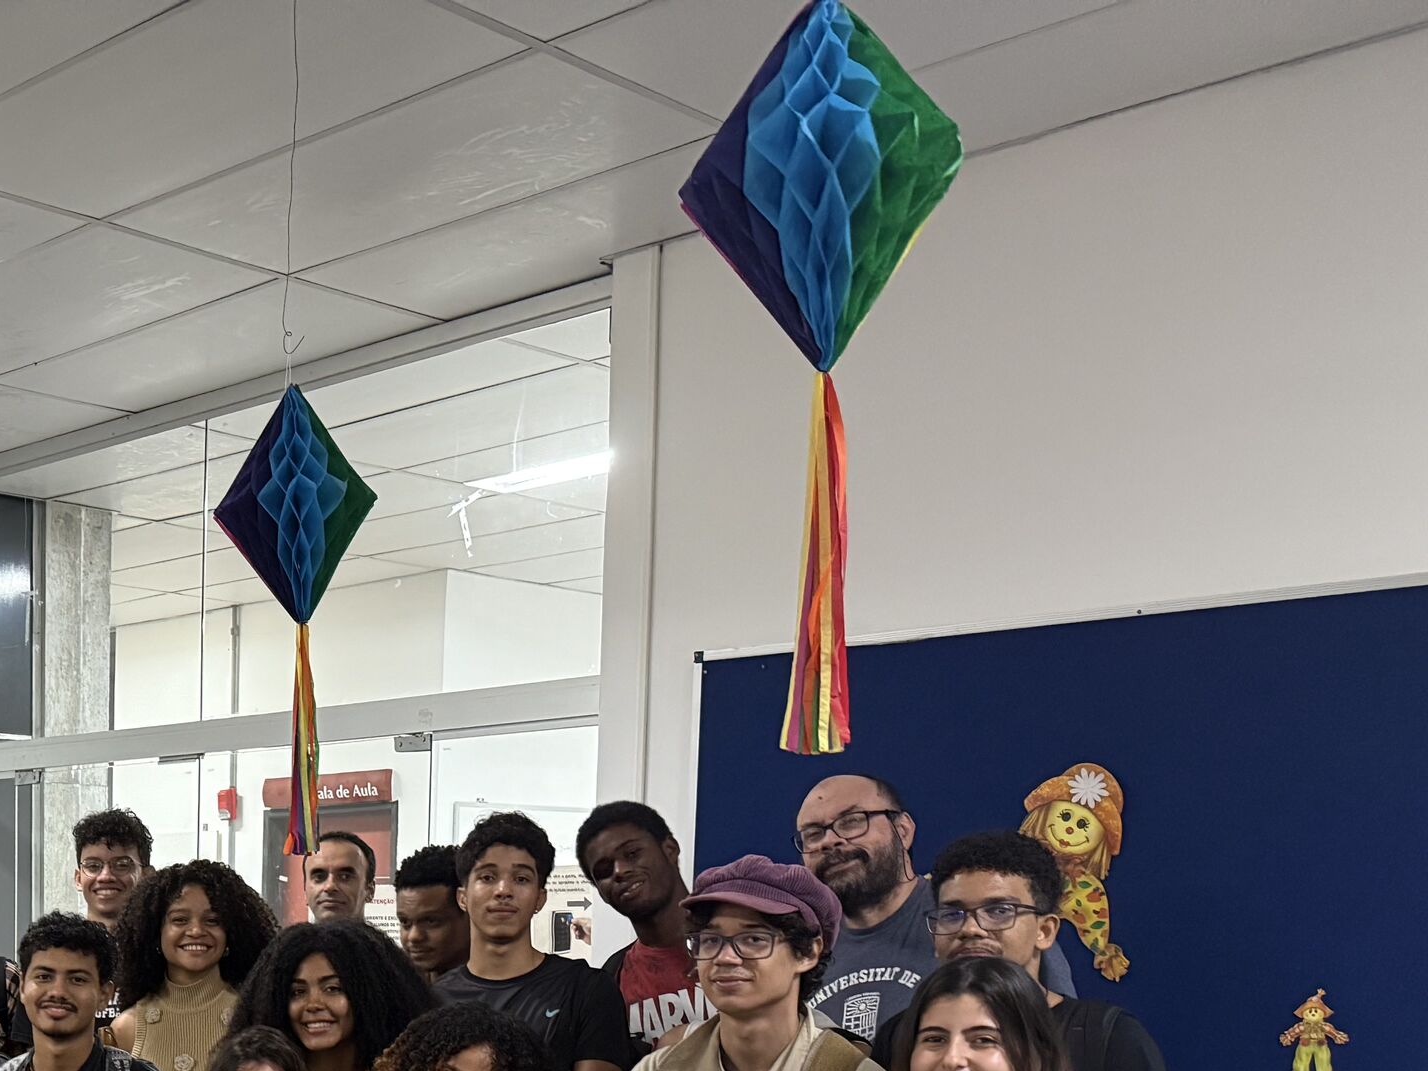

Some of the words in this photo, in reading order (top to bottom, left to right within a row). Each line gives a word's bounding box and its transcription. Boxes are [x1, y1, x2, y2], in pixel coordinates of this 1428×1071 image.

[317, 785, 334, 800] ala
[336, 784, 350, 798] de
[353, 782, 379, 797] Aula
[898, 970, 922, 988] DE
